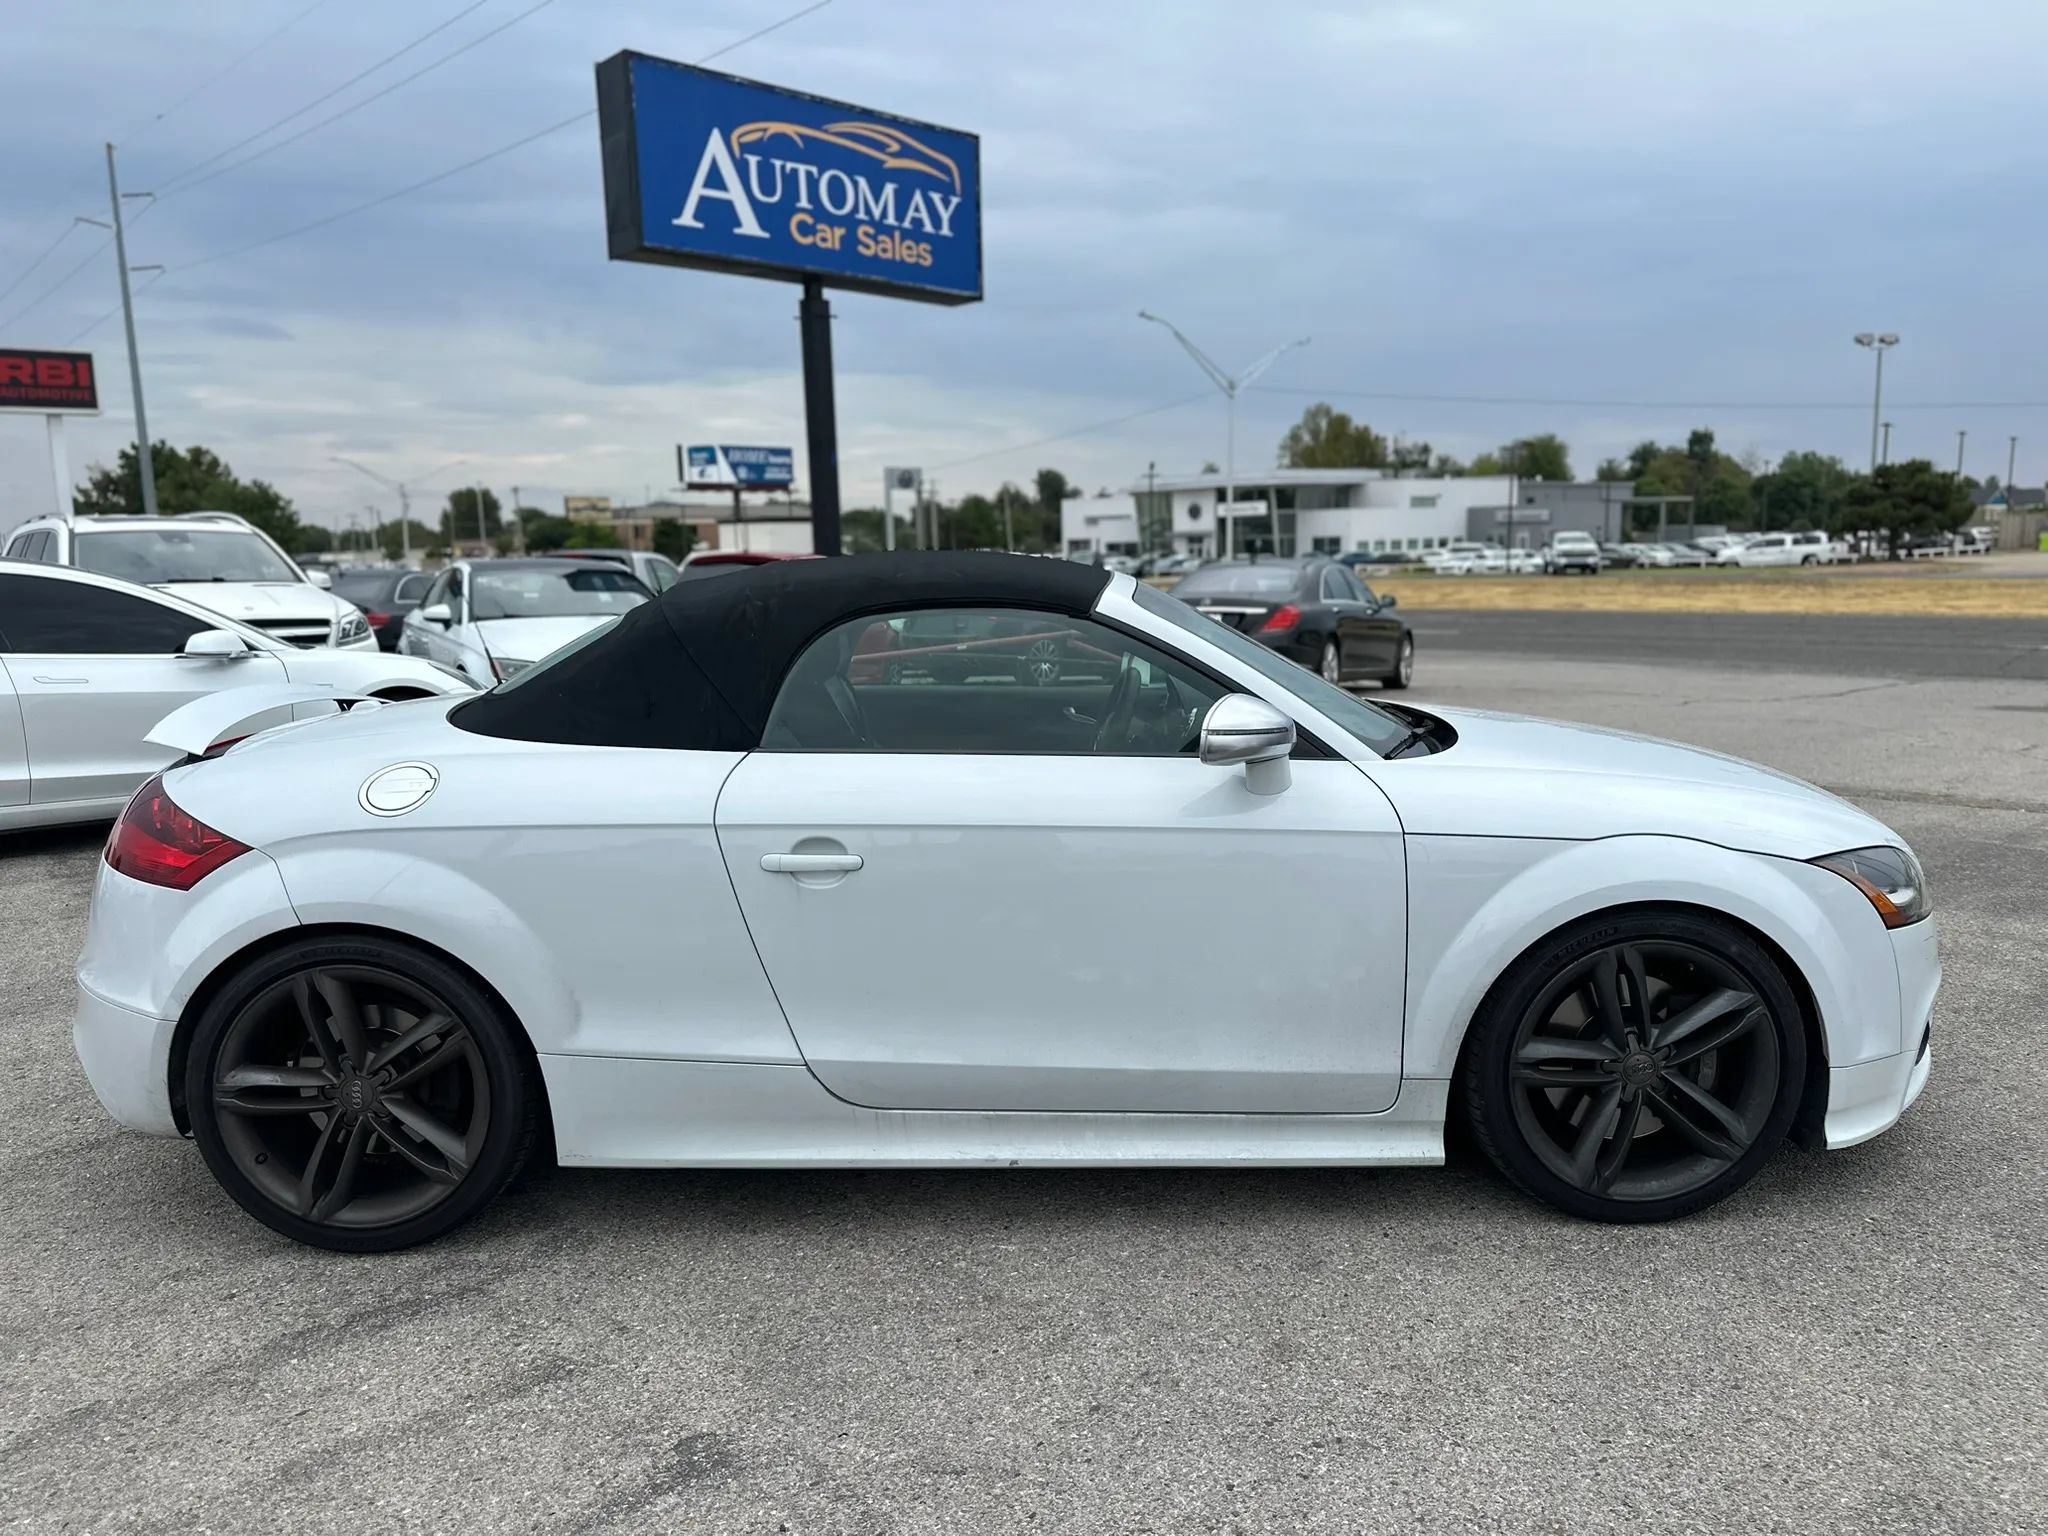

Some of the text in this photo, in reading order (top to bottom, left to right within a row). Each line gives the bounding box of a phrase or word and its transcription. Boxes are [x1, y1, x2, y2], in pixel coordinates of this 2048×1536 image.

[672, 127, 962, 239] AUTOMAY
[789, 213, 933, 267] Car Sales
